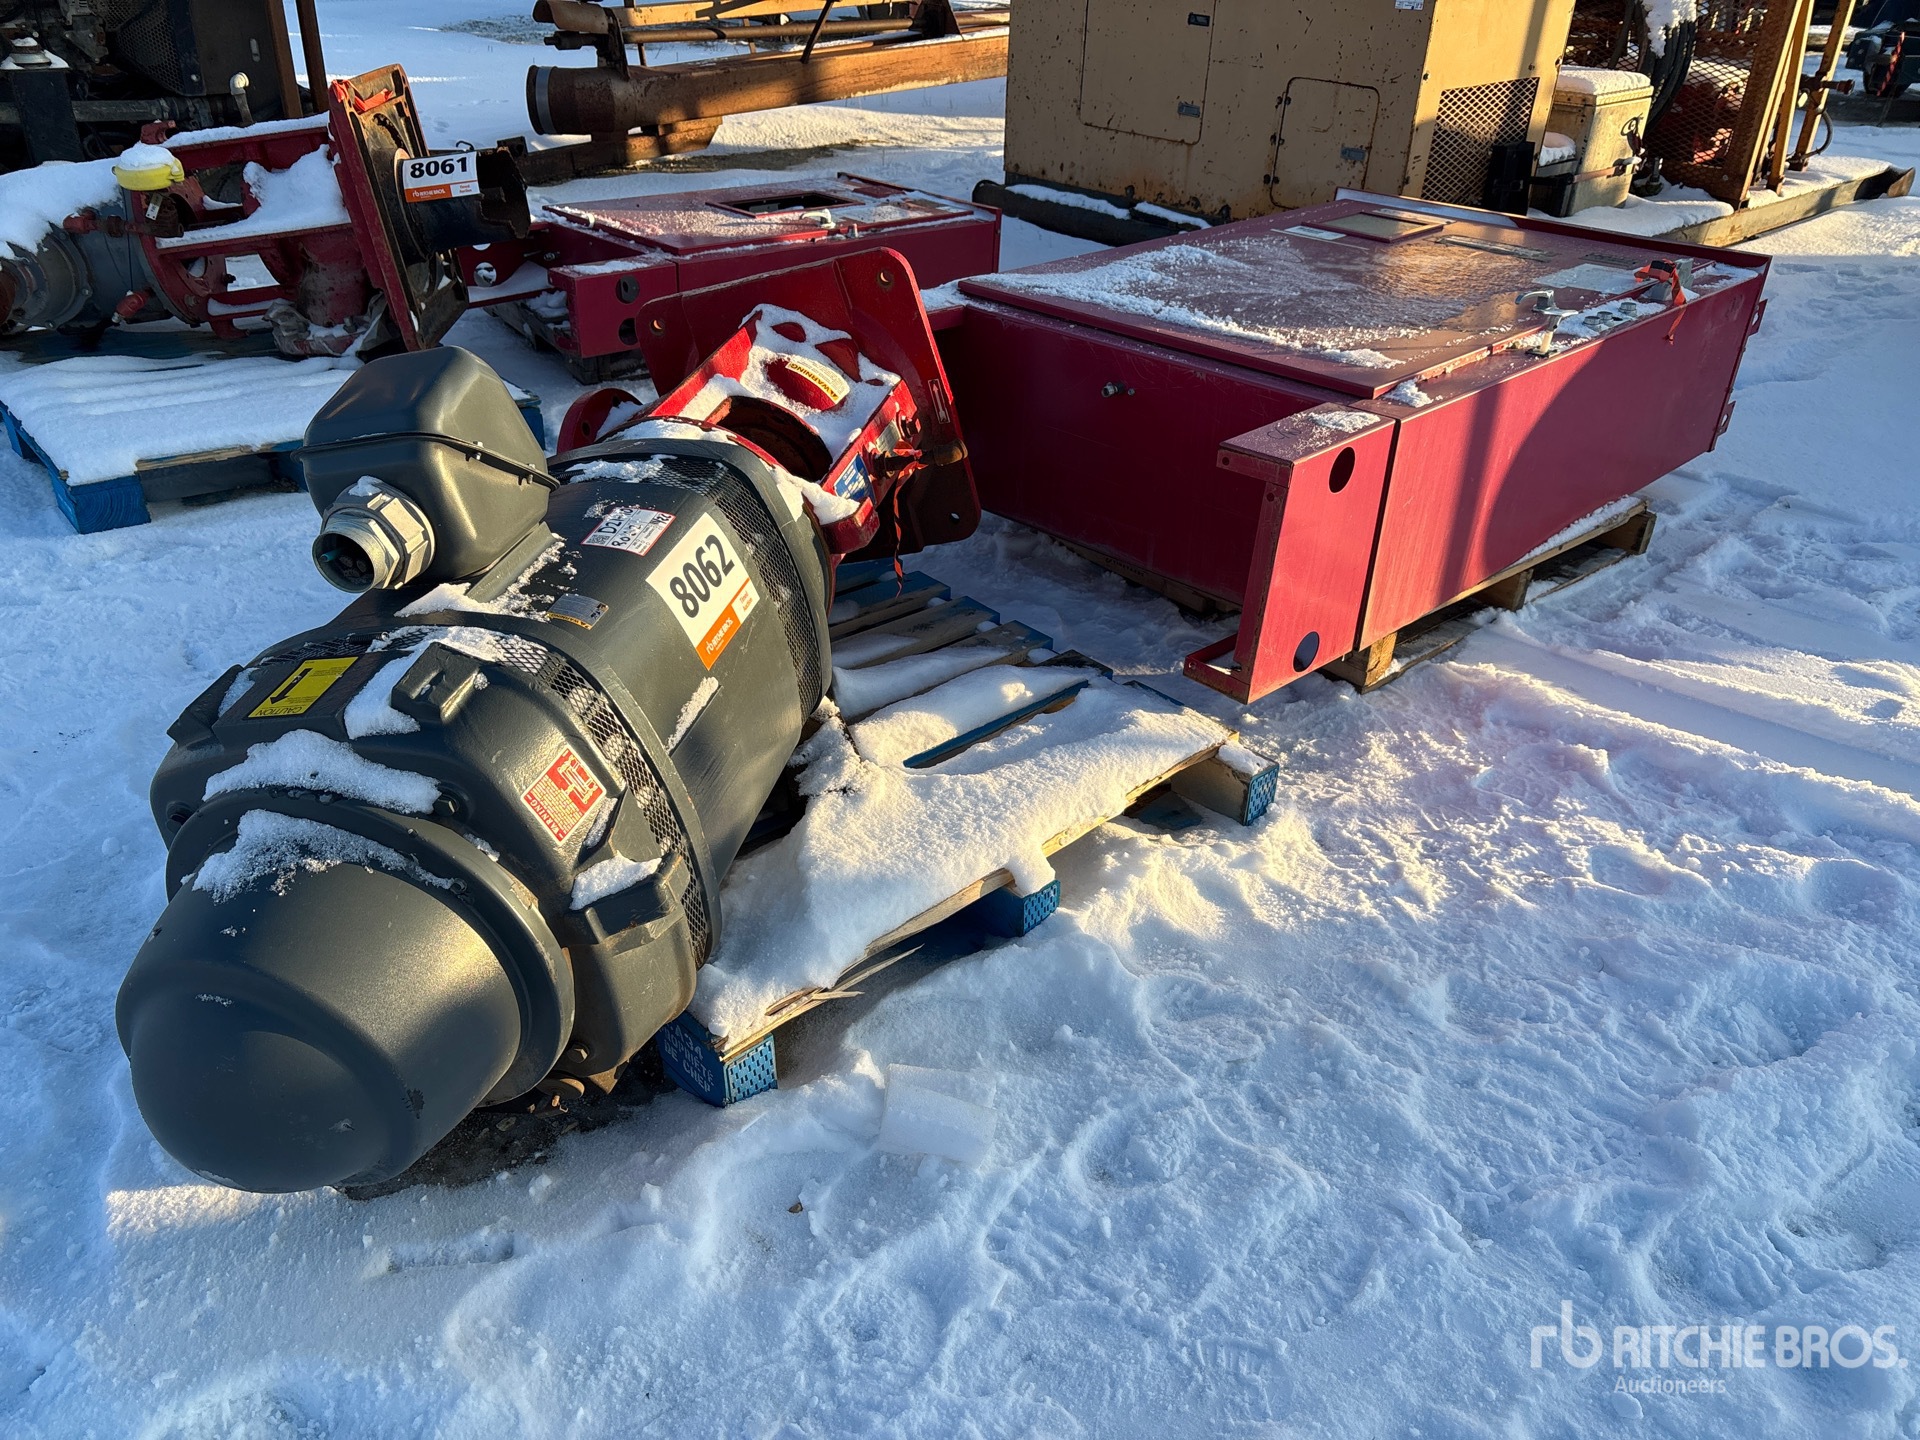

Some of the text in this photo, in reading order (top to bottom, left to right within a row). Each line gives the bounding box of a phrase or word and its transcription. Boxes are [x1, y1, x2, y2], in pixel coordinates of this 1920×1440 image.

[410, 157, 467, 178] 8061
[790, 363, 832, 393] WARNING
[669, 534, 735, 618] 8062
[255, 706, 303, 716] CAUTION
[530, 799, 561, 835] WARNING
